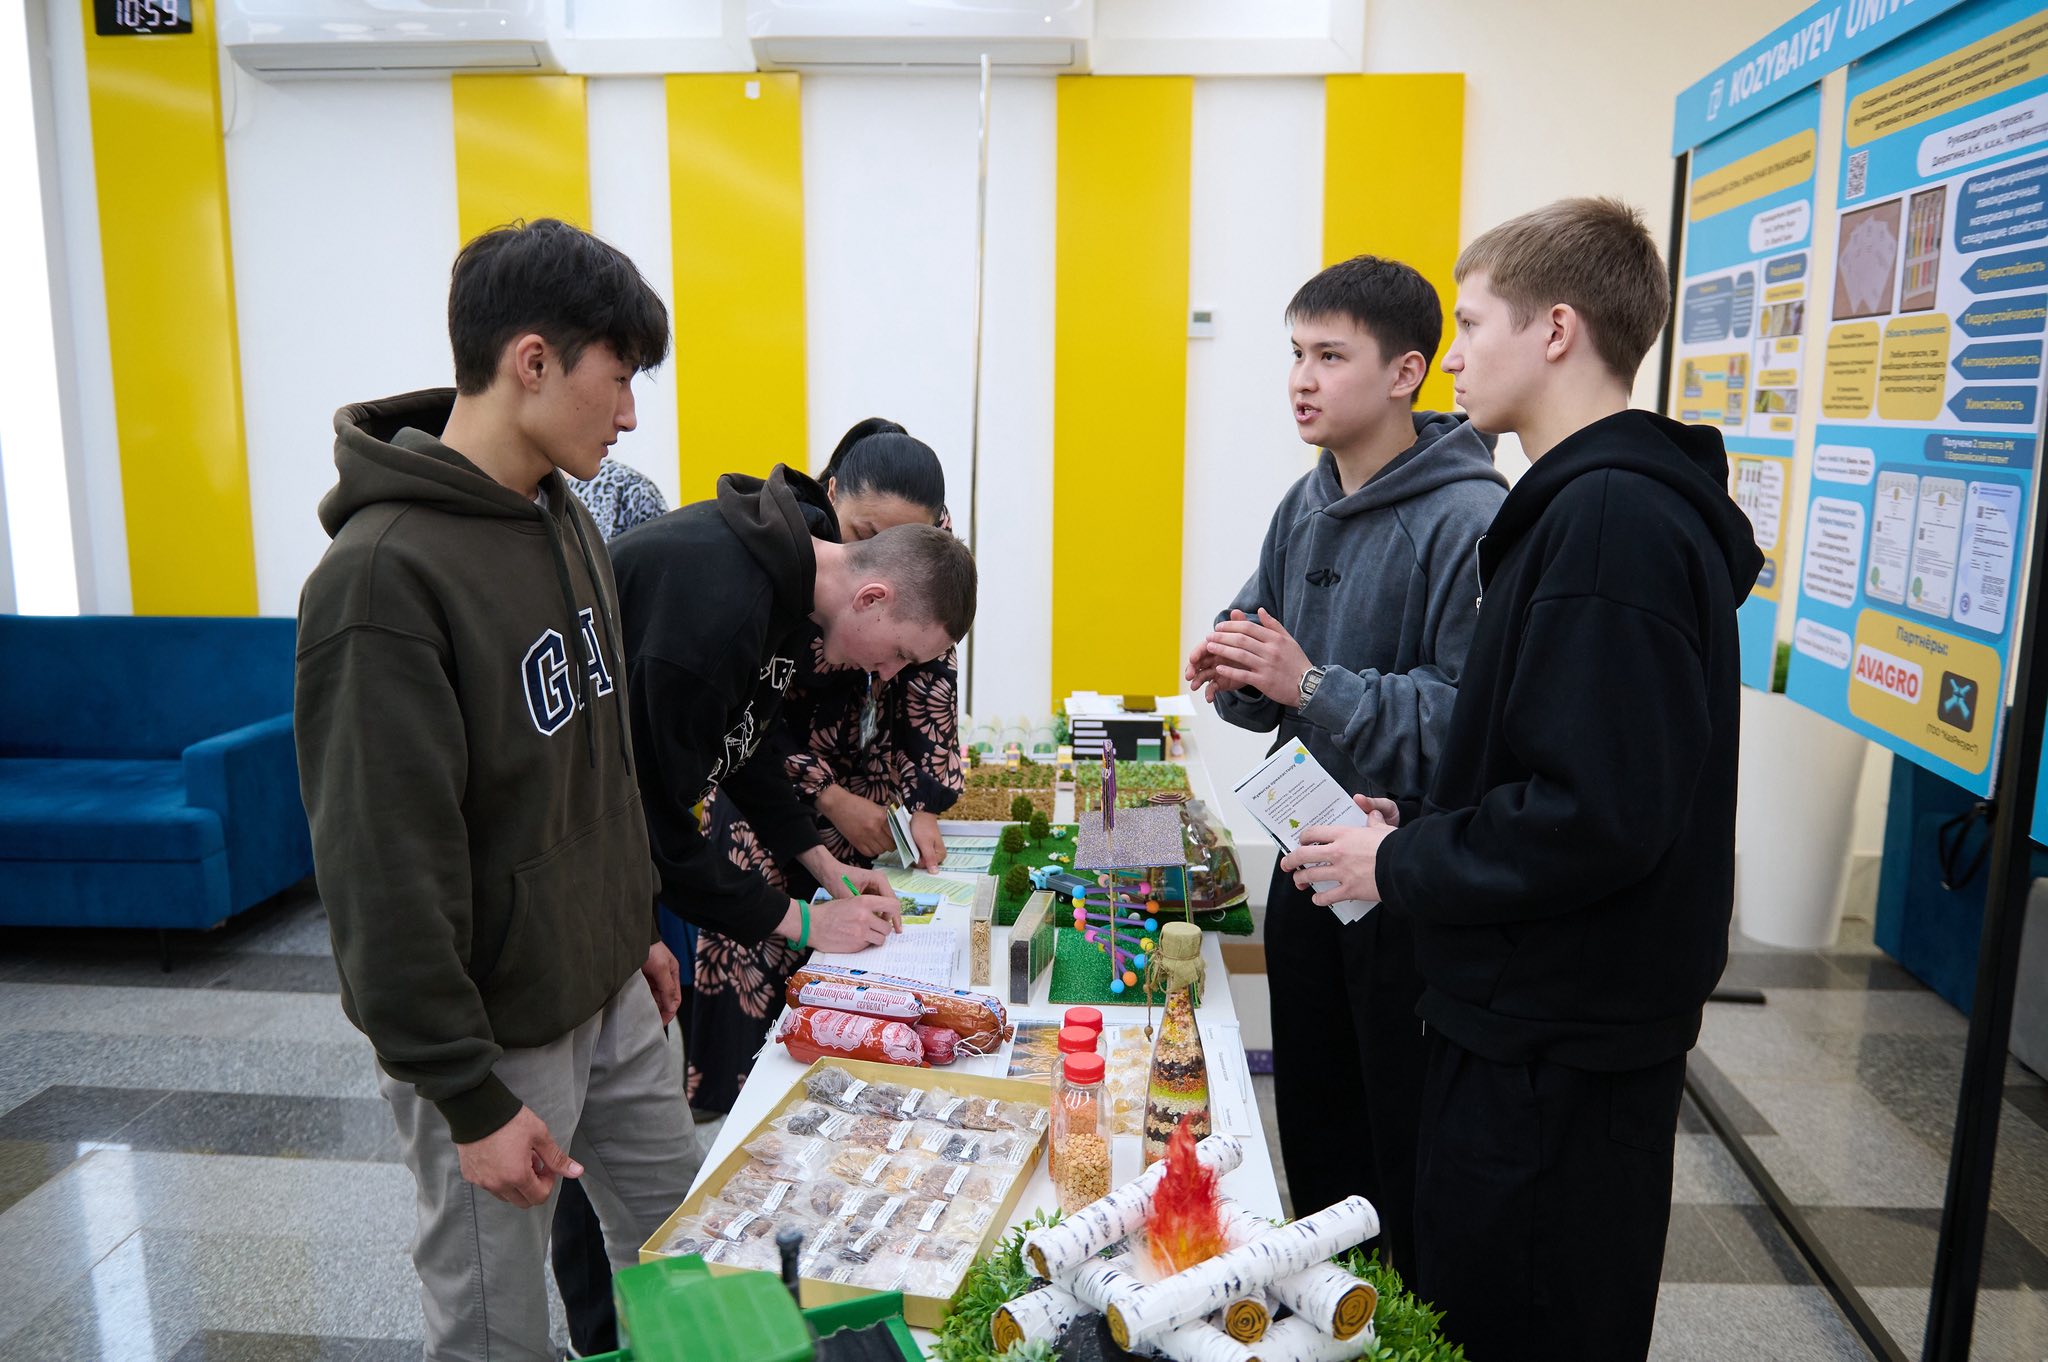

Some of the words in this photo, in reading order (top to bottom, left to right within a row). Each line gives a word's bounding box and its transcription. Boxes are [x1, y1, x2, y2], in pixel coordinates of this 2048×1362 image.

[1728, 6, 1841, 108] KOZYBAYEV
[522, 607, 622, 736] GA
[1856, 654, 1919, 698] AVAGRO
[1897, 625, 1949, 656] Партнёры:
